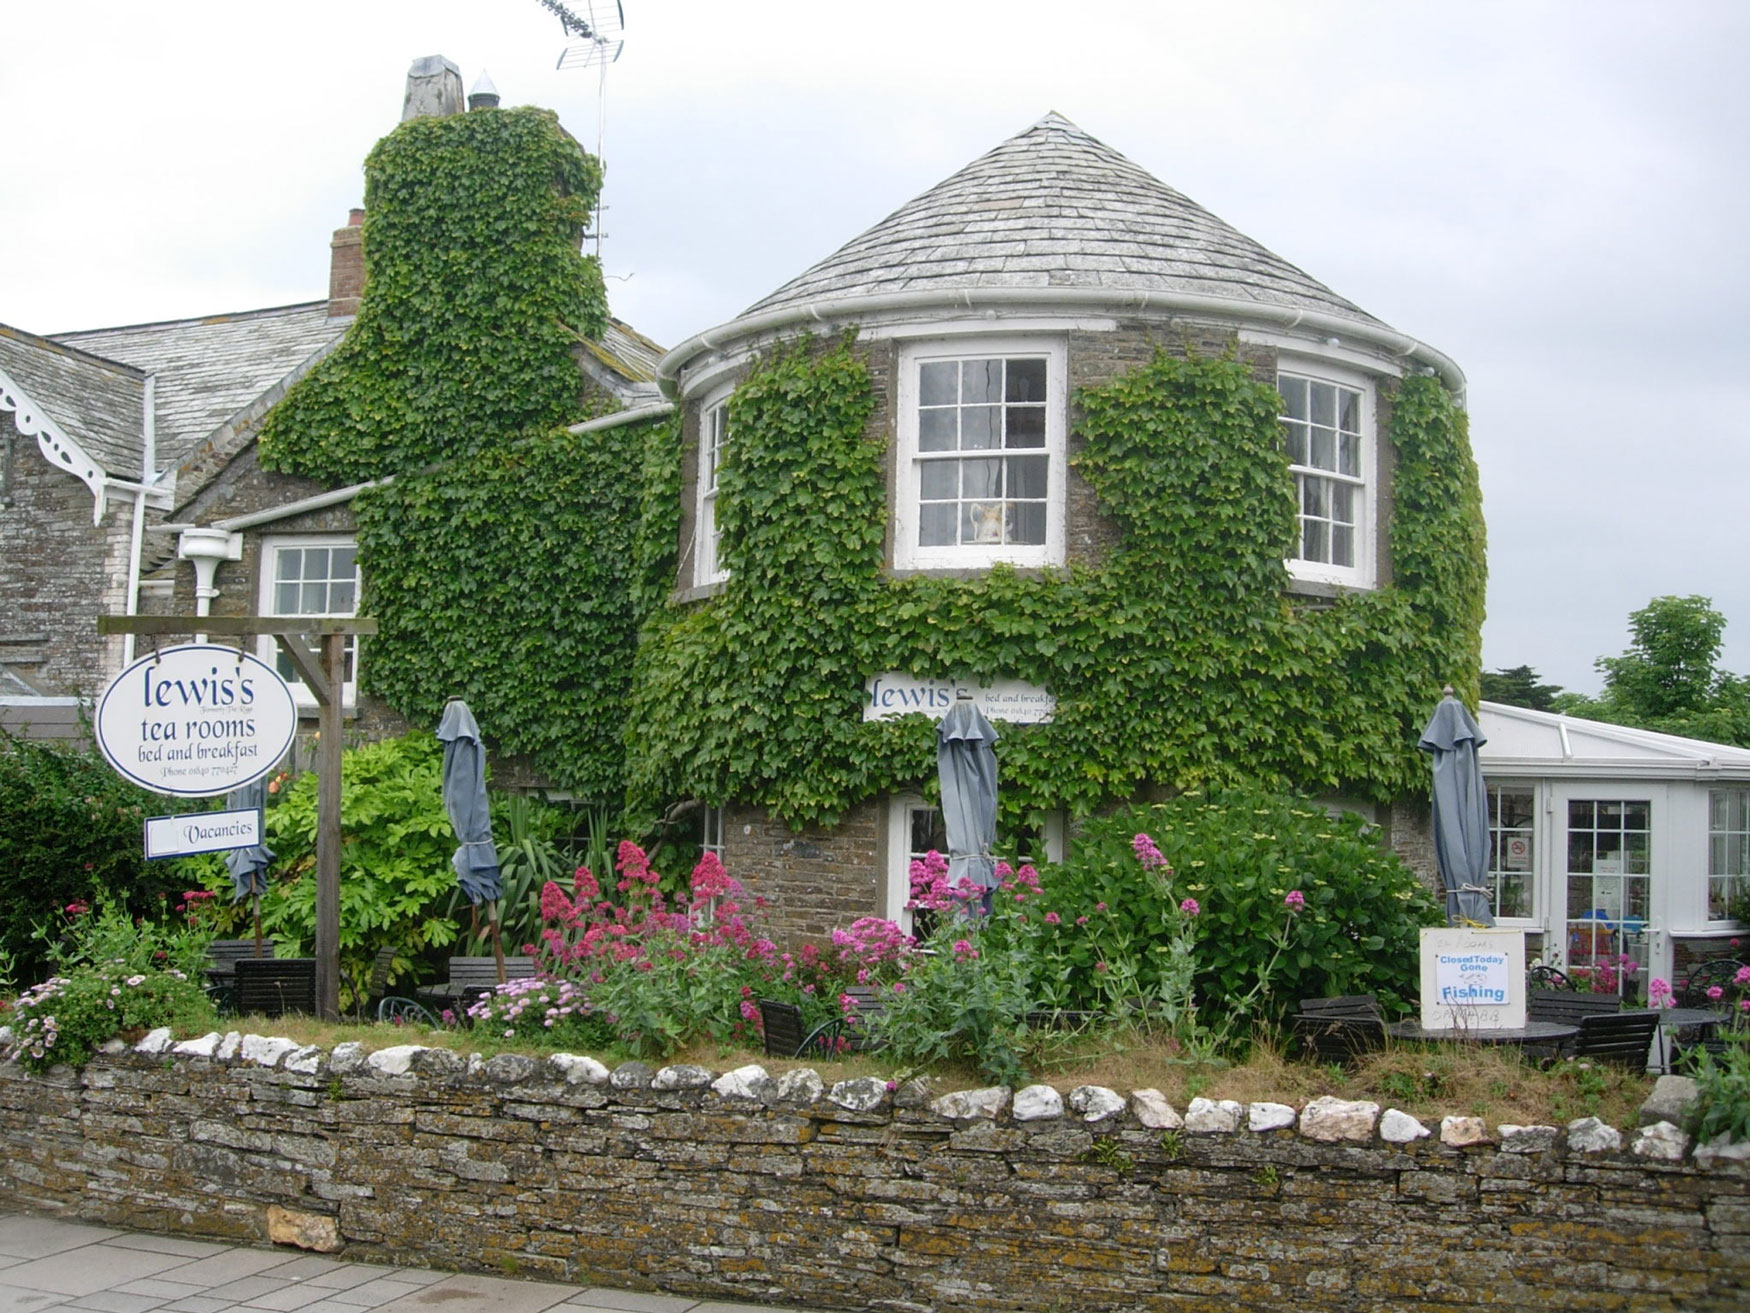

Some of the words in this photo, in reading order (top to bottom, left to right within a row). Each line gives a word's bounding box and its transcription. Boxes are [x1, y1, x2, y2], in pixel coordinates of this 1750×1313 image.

[144, 666, 254, 707] lewis's
[985, 693, 1000, 703] bed
[1002, 693, 1019, 703] and
[984, 706, 1008, 715] Phone
[140, 718, 176, 741] tea
[186, 718, 256, 740] rooms
[138, 744, 163, 762] bed
[167, 742, 194, 761] and
[197, 741, 258, 765] breakfast
[161, 766, 187, 777] Phone
[183, 821, 253, 845] Vacancies
[1440, 955, 1473, 964] Closed
[1474, 955, 1504, 965] Today
[1460, 964, 1488, 972] Gone
[1442, 984, 1505, 1001] Fishing
